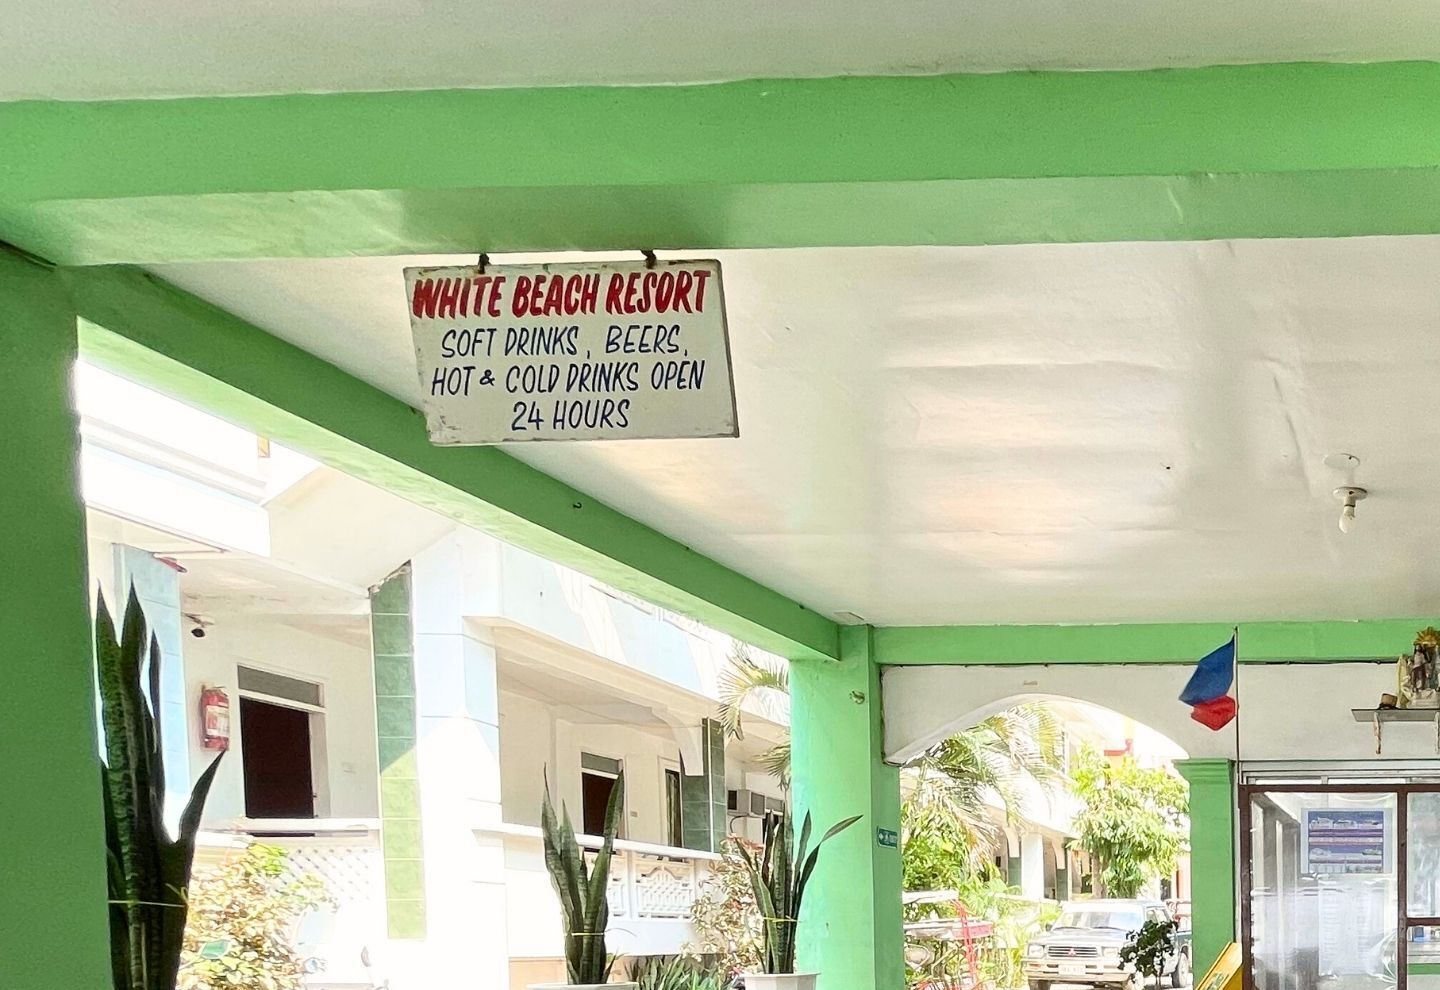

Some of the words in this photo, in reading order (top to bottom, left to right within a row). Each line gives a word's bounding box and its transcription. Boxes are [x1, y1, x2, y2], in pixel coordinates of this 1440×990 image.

[412, 275, 506, 319] WHITE
[511, 273, 601, 318] BEACH
[605, 270, 711, 316] RESORT
[441, 328, 497, 358] SOFT
[605, 324, 689, 358] BEERS,
[431, 366, 476, 396] HOT
[478, 369, 496, 387] &
[505, 363, 560, 394] COLD
[565, 361, 640, 393] DRINKS
[650, 360, 705, 391] OPEN
[511, 400, 545, 431] 24
[552, 399, 631, 430] HOURS
